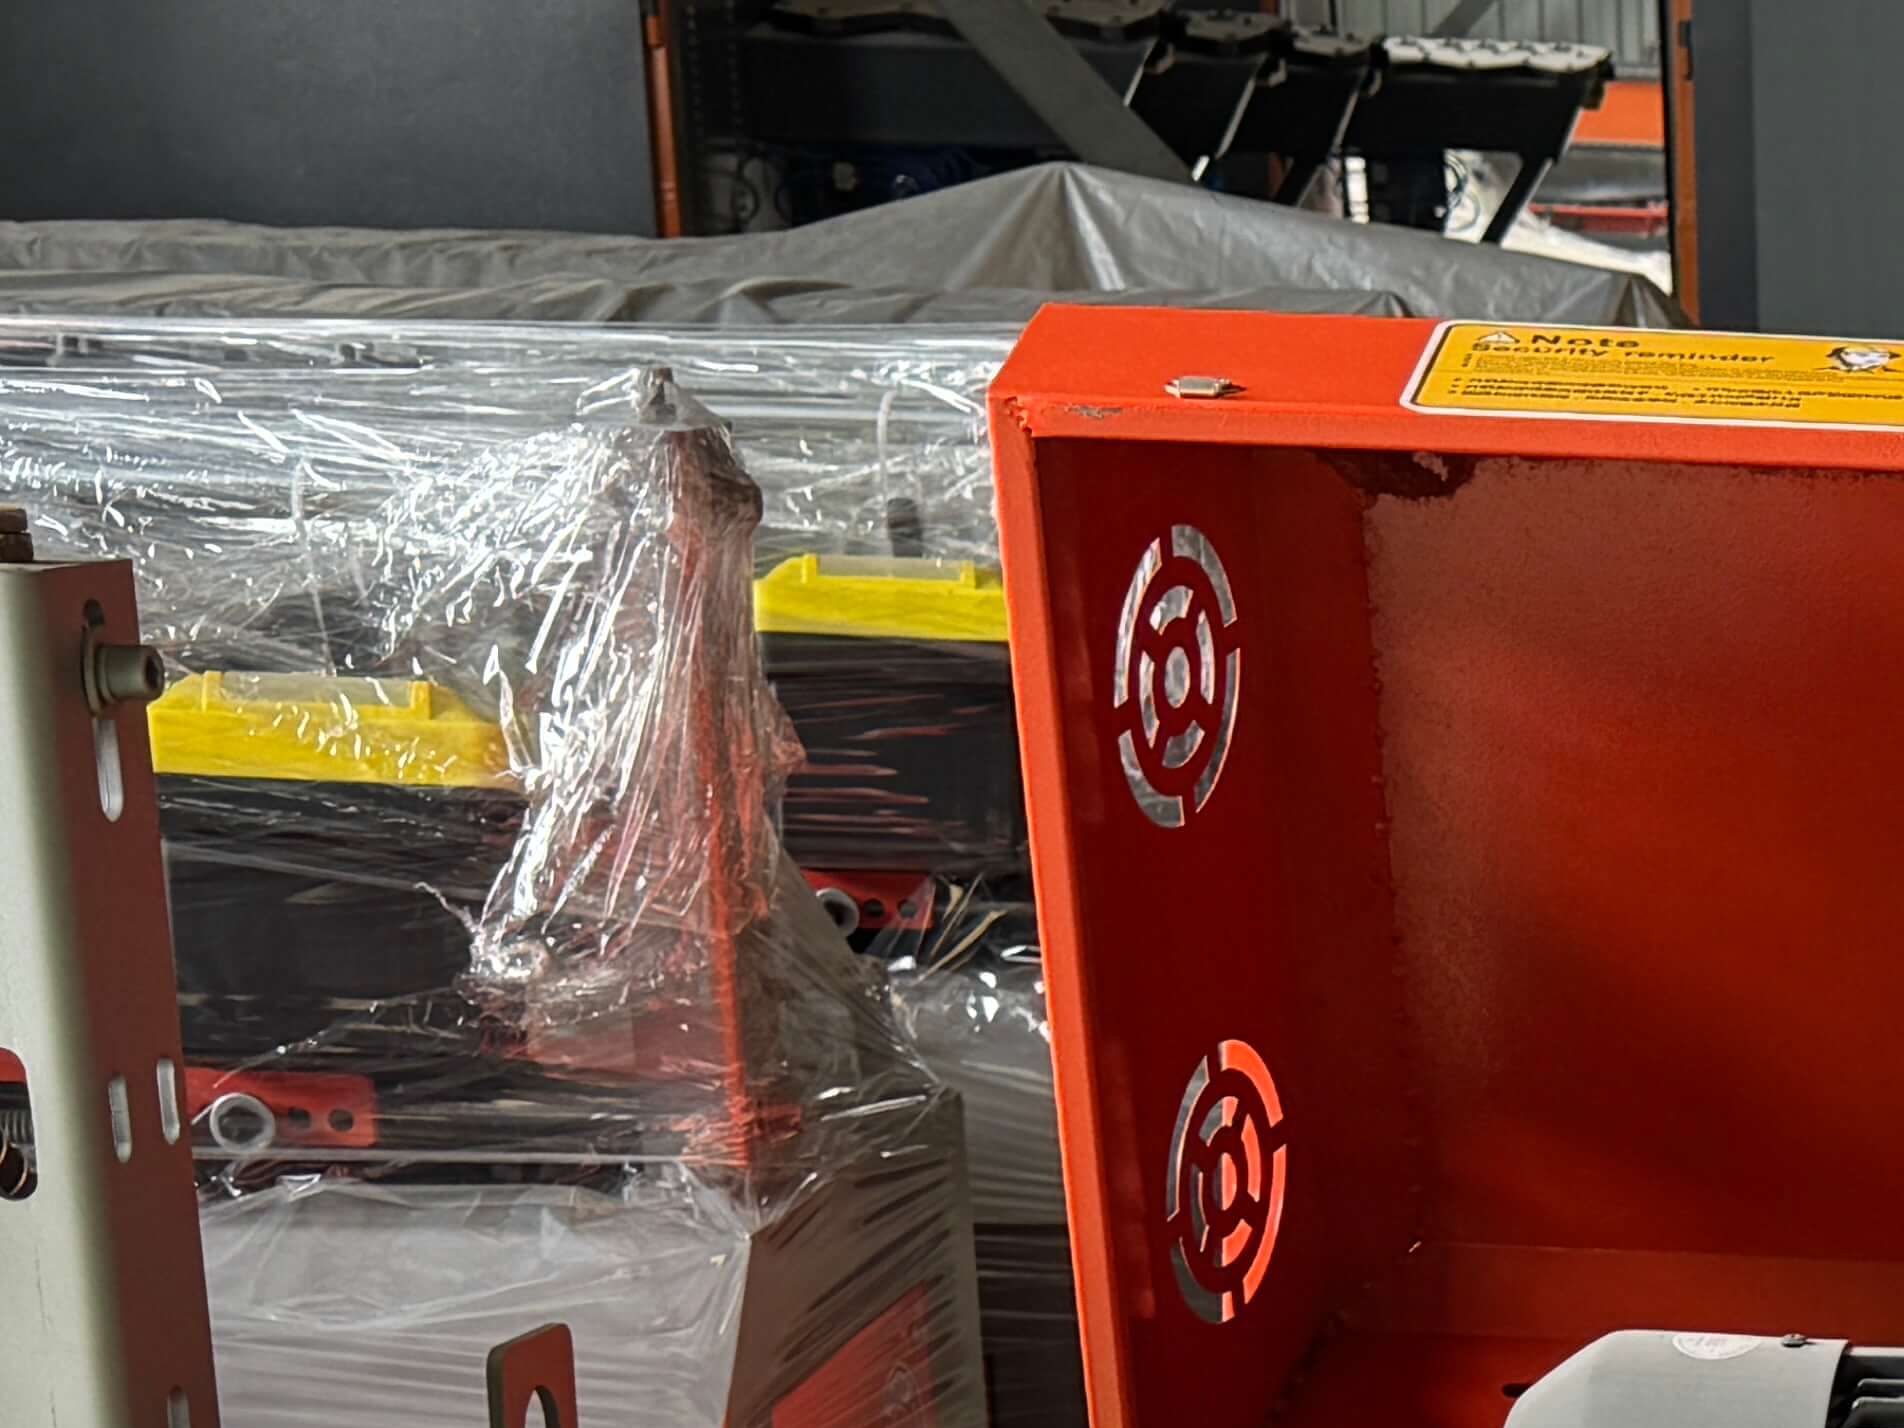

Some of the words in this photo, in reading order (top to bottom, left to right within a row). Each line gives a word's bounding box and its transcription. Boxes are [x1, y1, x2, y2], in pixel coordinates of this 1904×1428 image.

[1529, 334, 1641, 348] Note
[1471, 342, 1609, 358] Security
[1624, 350, 1776, 363] reminder
